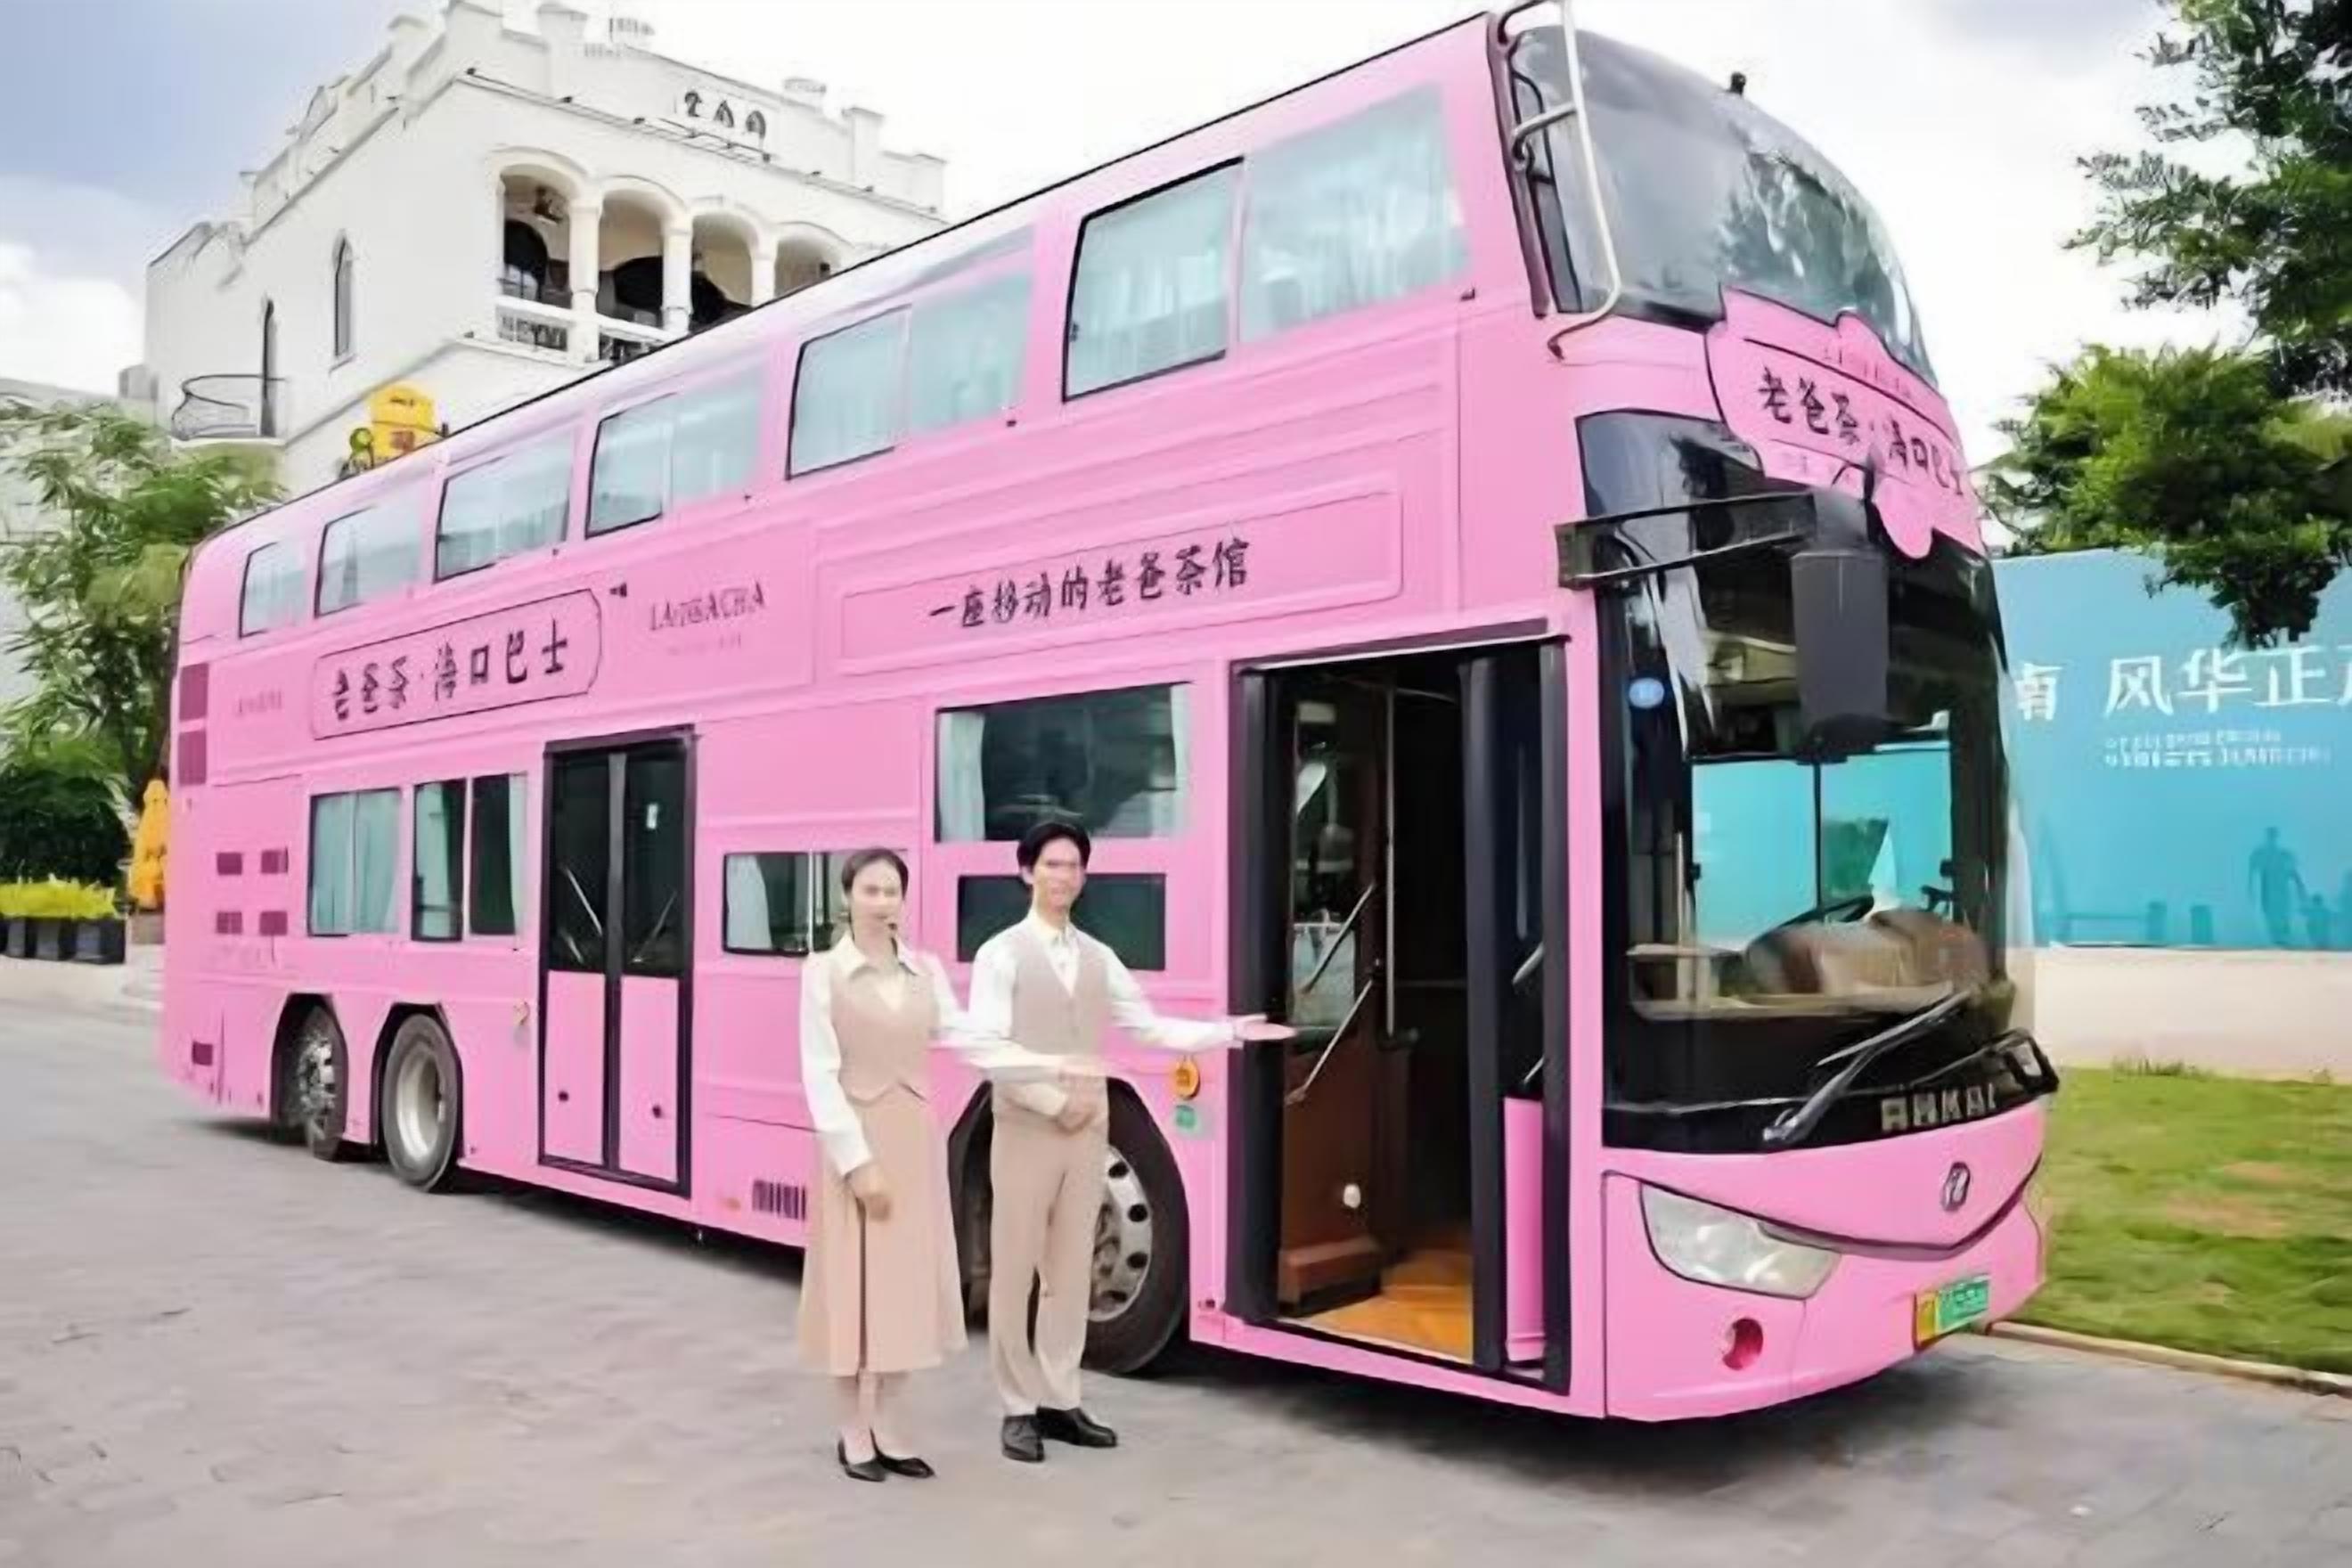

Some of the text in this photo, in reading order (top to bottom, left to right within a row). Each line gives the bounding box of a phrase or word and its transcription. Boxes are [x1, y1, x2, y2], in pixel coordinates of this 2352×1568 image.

[929, 536, 1250, 628] 一座移动的老爸茶馆
[2103, 643, 2352, 720] 风华正
